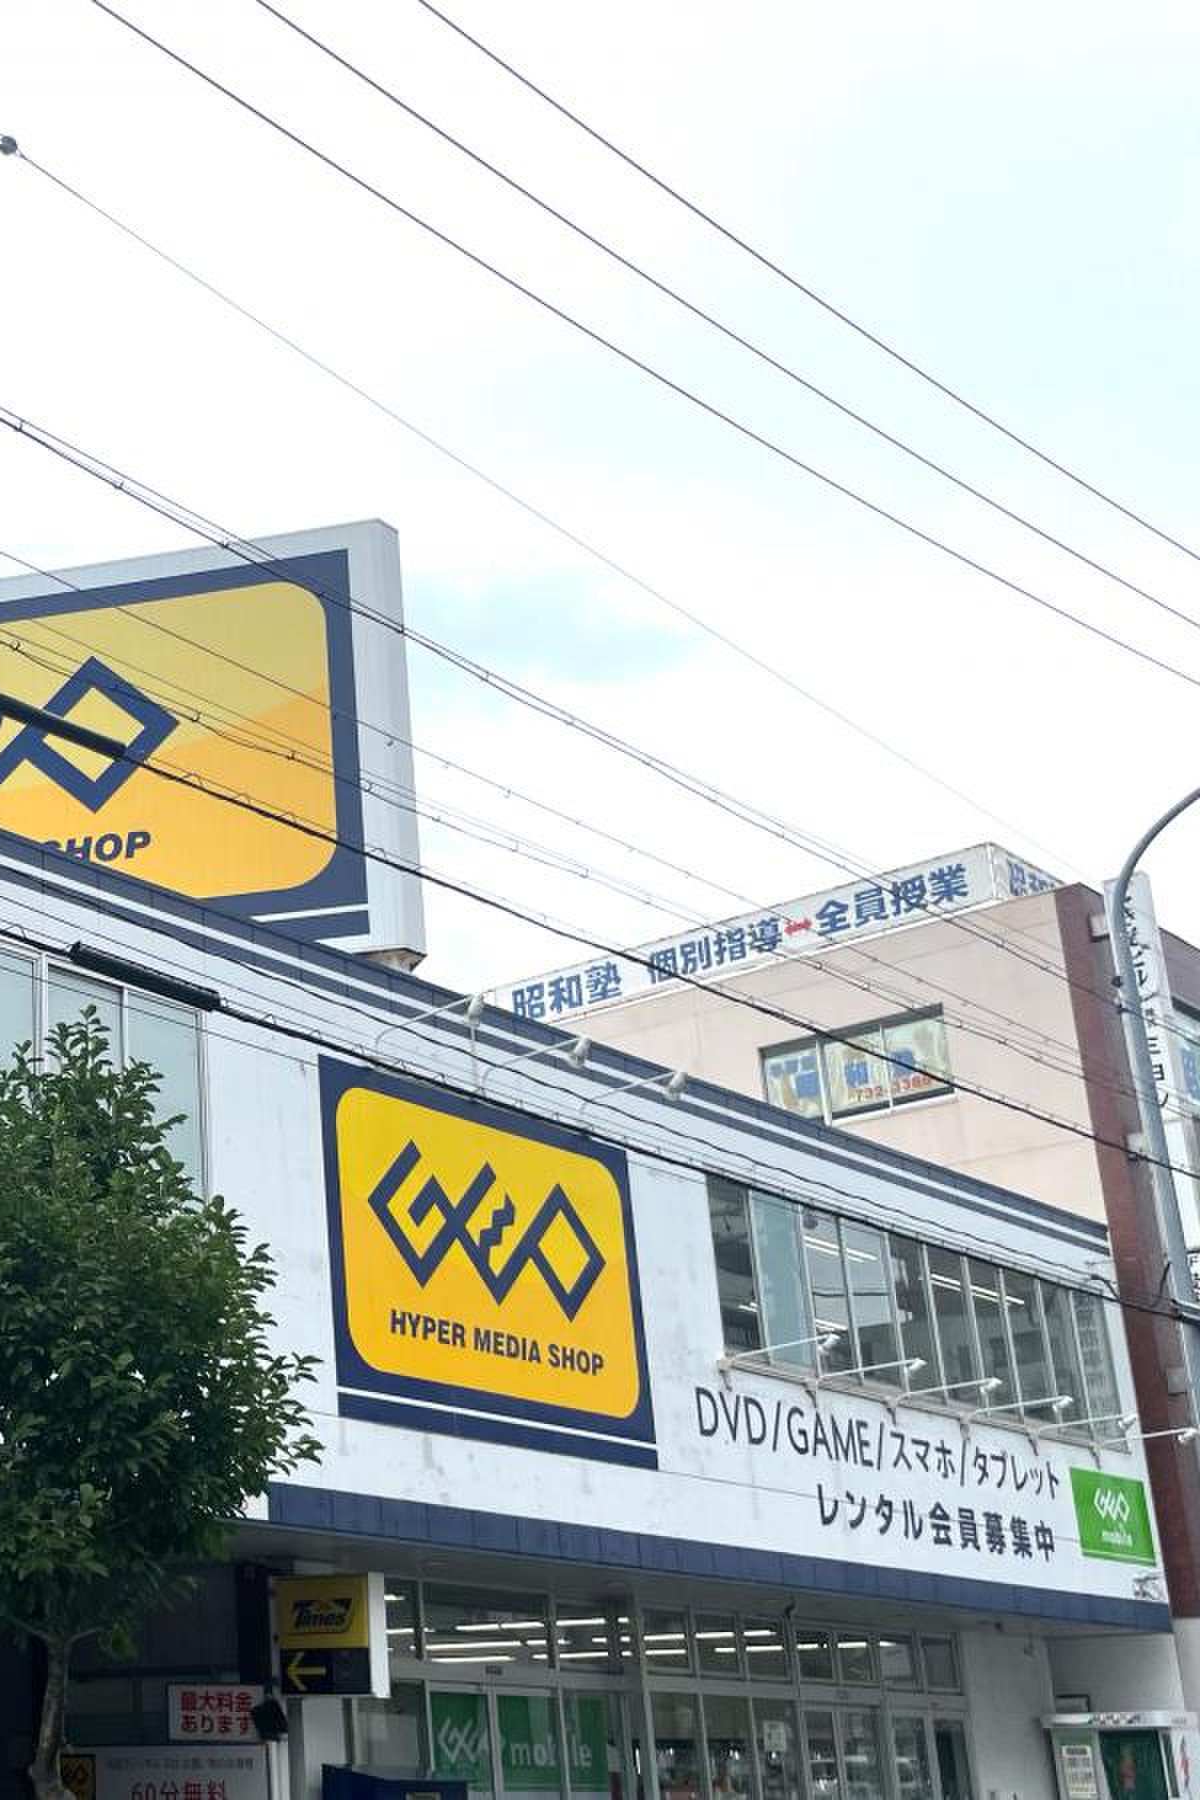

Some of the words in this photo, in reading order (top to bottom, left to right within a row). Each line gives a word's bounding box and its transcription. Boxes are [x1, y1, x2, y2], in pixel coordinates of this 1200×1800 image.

[511, 961, 622, 1020] 昭和塾
[646, 920, 784, 985] 個別指導
[814, 862, 970, 936] 全員授業
[368, 1140, 607, 1324] GEO
[390, 1309, 466, 1348] HYPER
[473, 1327, 541, 1363] MEDIA
[548, 1342, 605, 1377] SHOP
[816, 1482, 1056, 1562] レンタル会員募集中
[180, 1690, 253, 1712] 最大料金
[180, 1713, 252, 1735] あります
